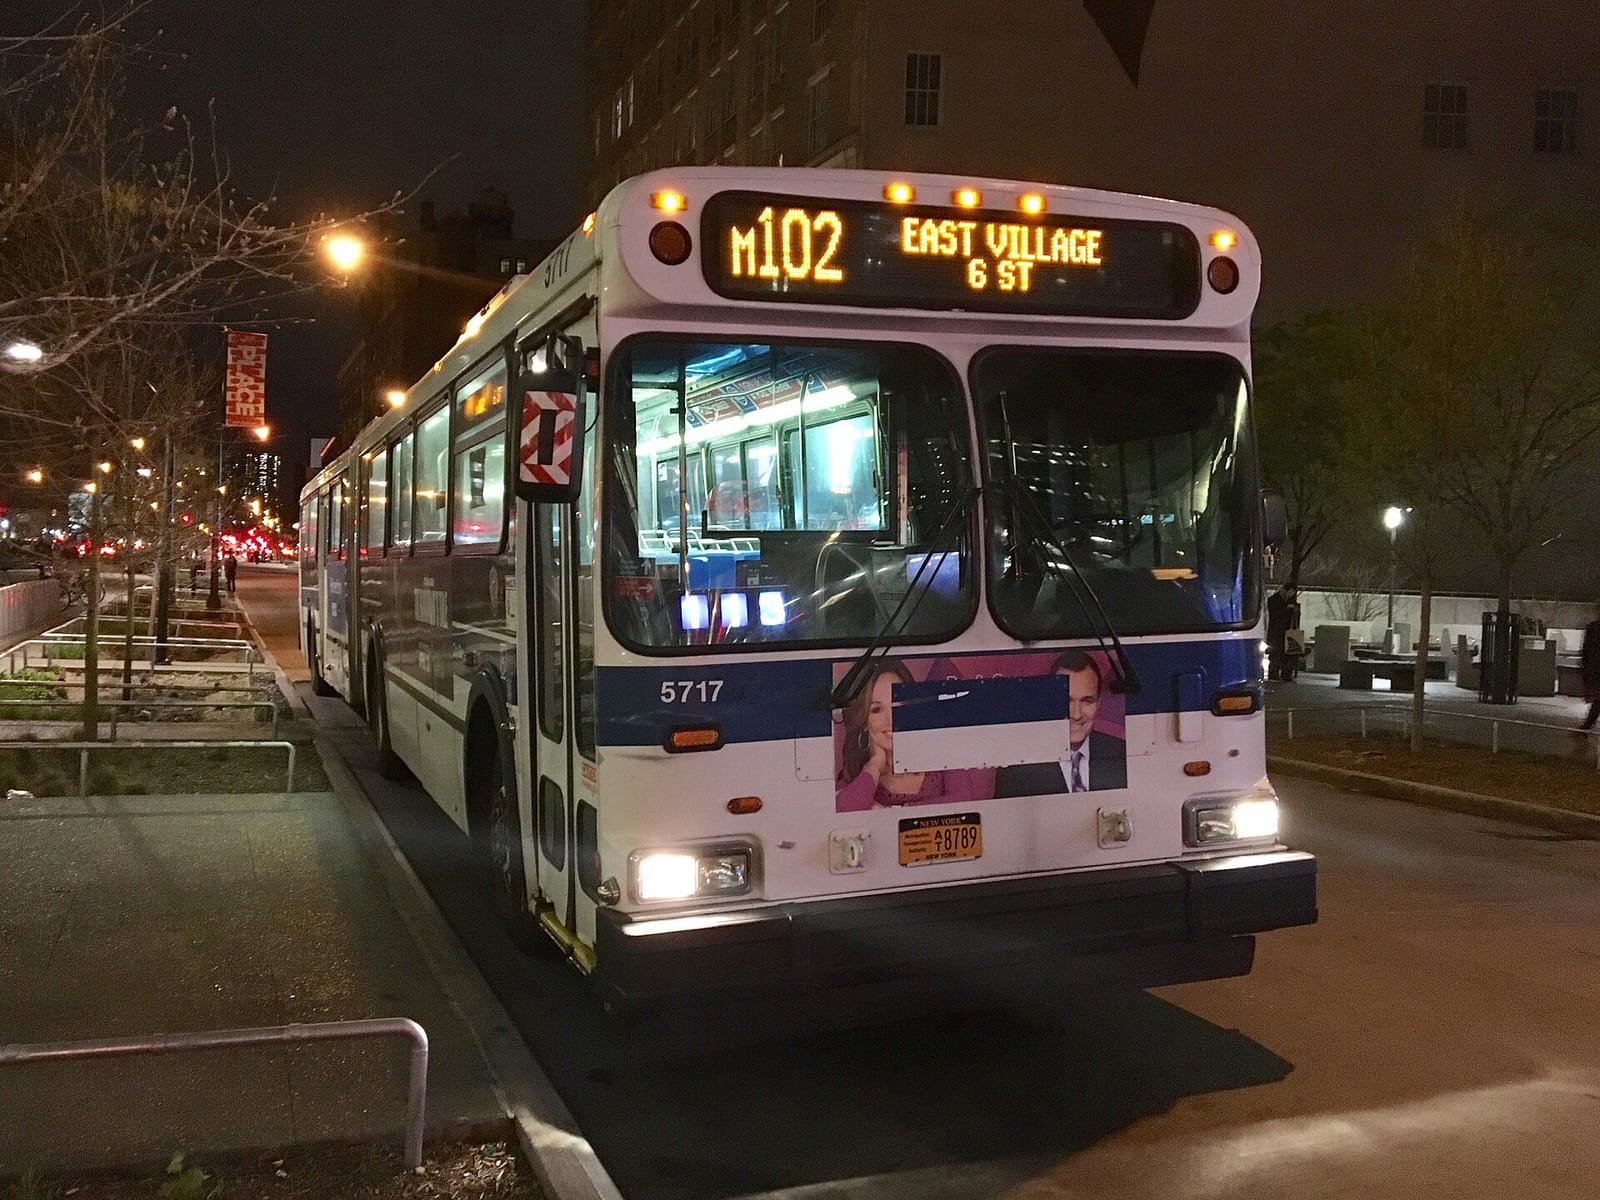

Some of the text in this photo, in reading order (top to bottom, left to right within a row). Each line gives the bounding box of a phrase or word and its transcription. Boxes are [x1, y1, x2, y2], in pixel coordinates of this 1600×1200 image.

[731, 206, 843, 281] M102
[902, 217, 1102, 264] EAST VILLAGE
[968, 258, 1034, 291] 6 ST
[236, 345, 257, 416] PLACE
[660, 680, 724, 703] 5717
